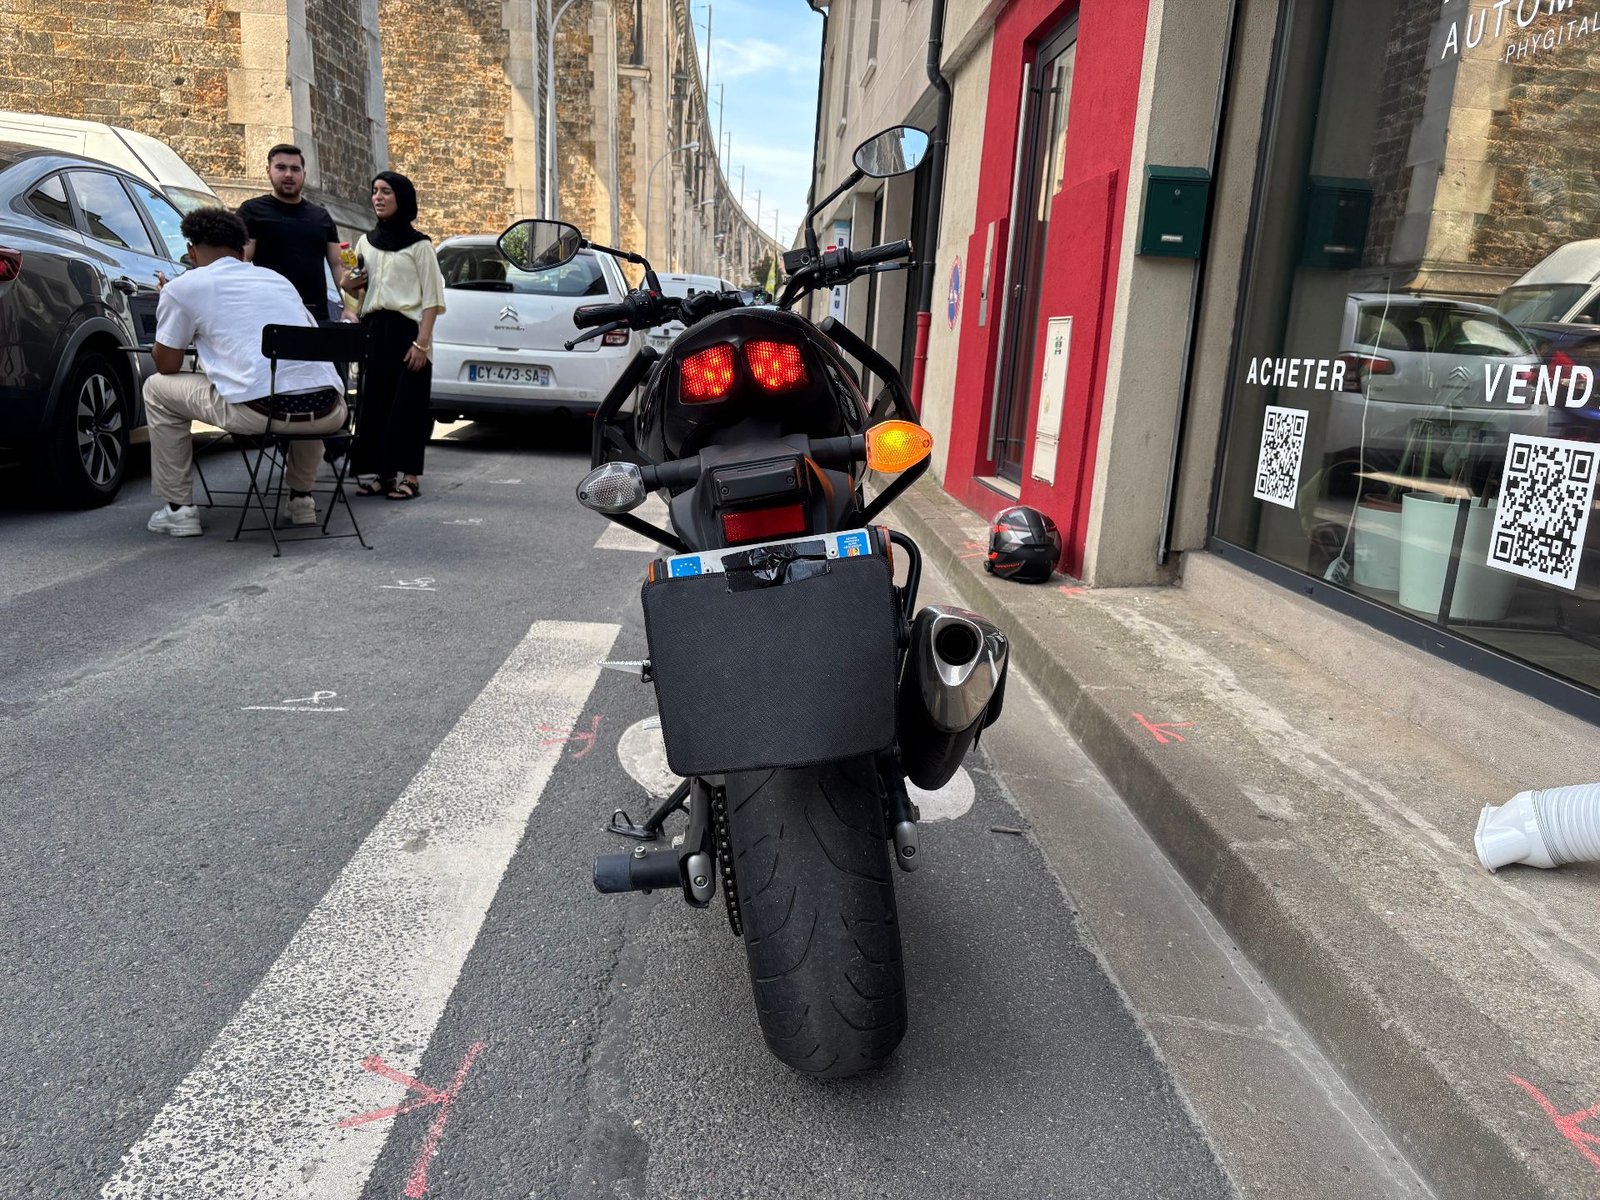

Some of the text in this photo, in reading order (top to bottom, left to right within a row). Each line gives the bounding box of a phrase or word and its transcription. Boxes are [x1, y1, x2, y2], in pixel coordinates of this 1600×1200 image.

[477, 366, 540, 382] CY-473-SA
[1246, 357, 1346, 392] ACHETER
[1484, 363, 1600, 409] VEND
